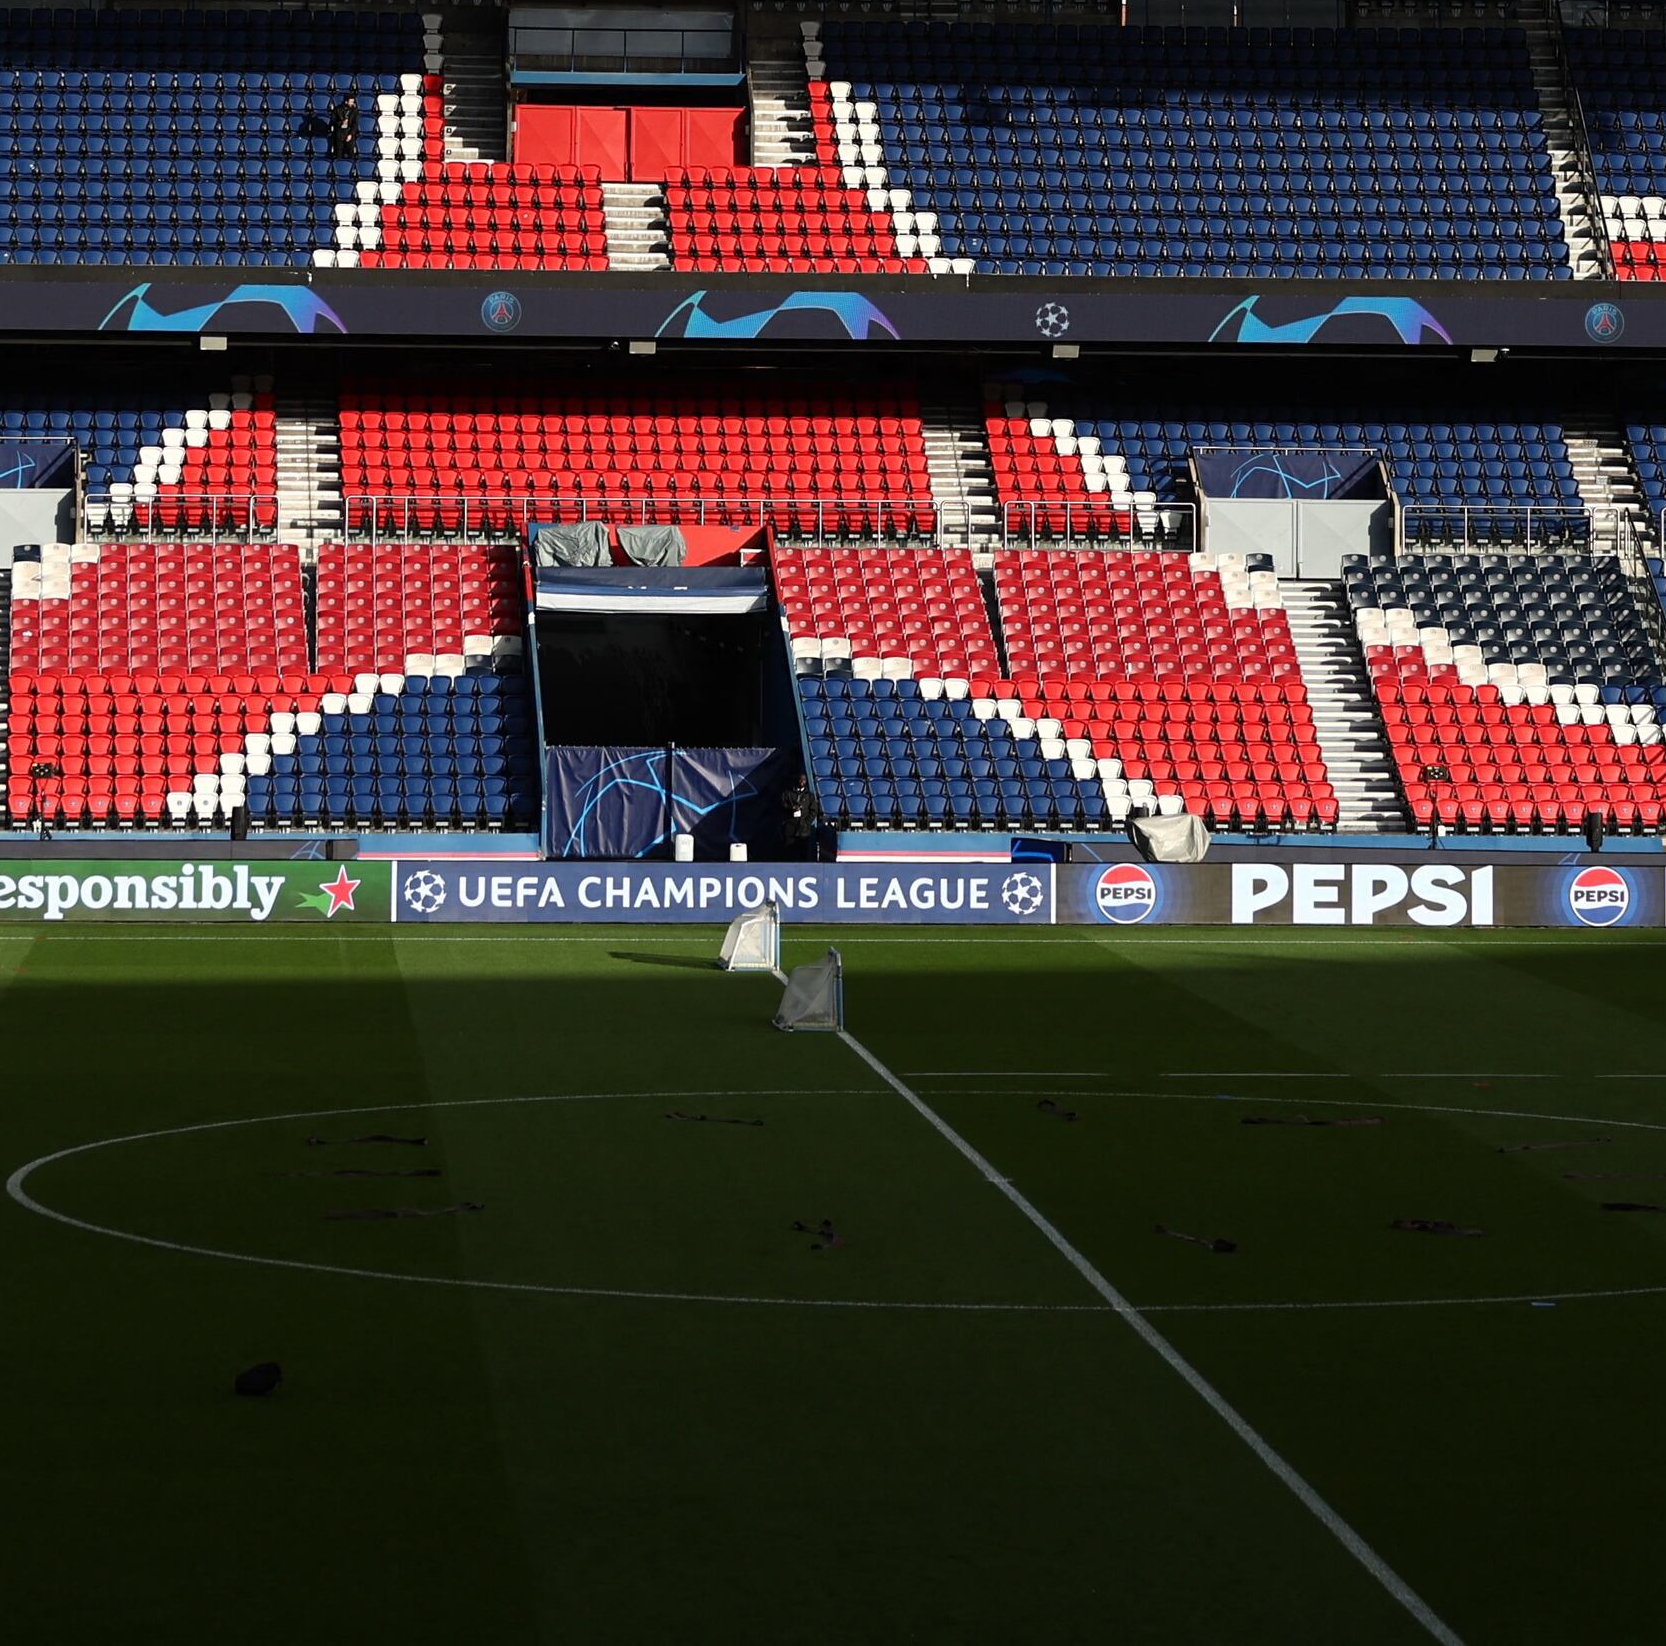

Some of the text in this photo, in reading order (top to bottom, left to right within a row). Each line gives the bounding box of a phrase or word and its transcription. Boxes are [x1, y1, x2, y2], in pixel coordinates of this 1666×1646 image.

[458, 876, 990, 910] UEFA CHAMPIONS LEAGUE
[1100, 887, 1152, 900] PEPSI
[1231, 863, 1494, 926] PEPSI
[1574, 890, 1625, 903] PEPSI
